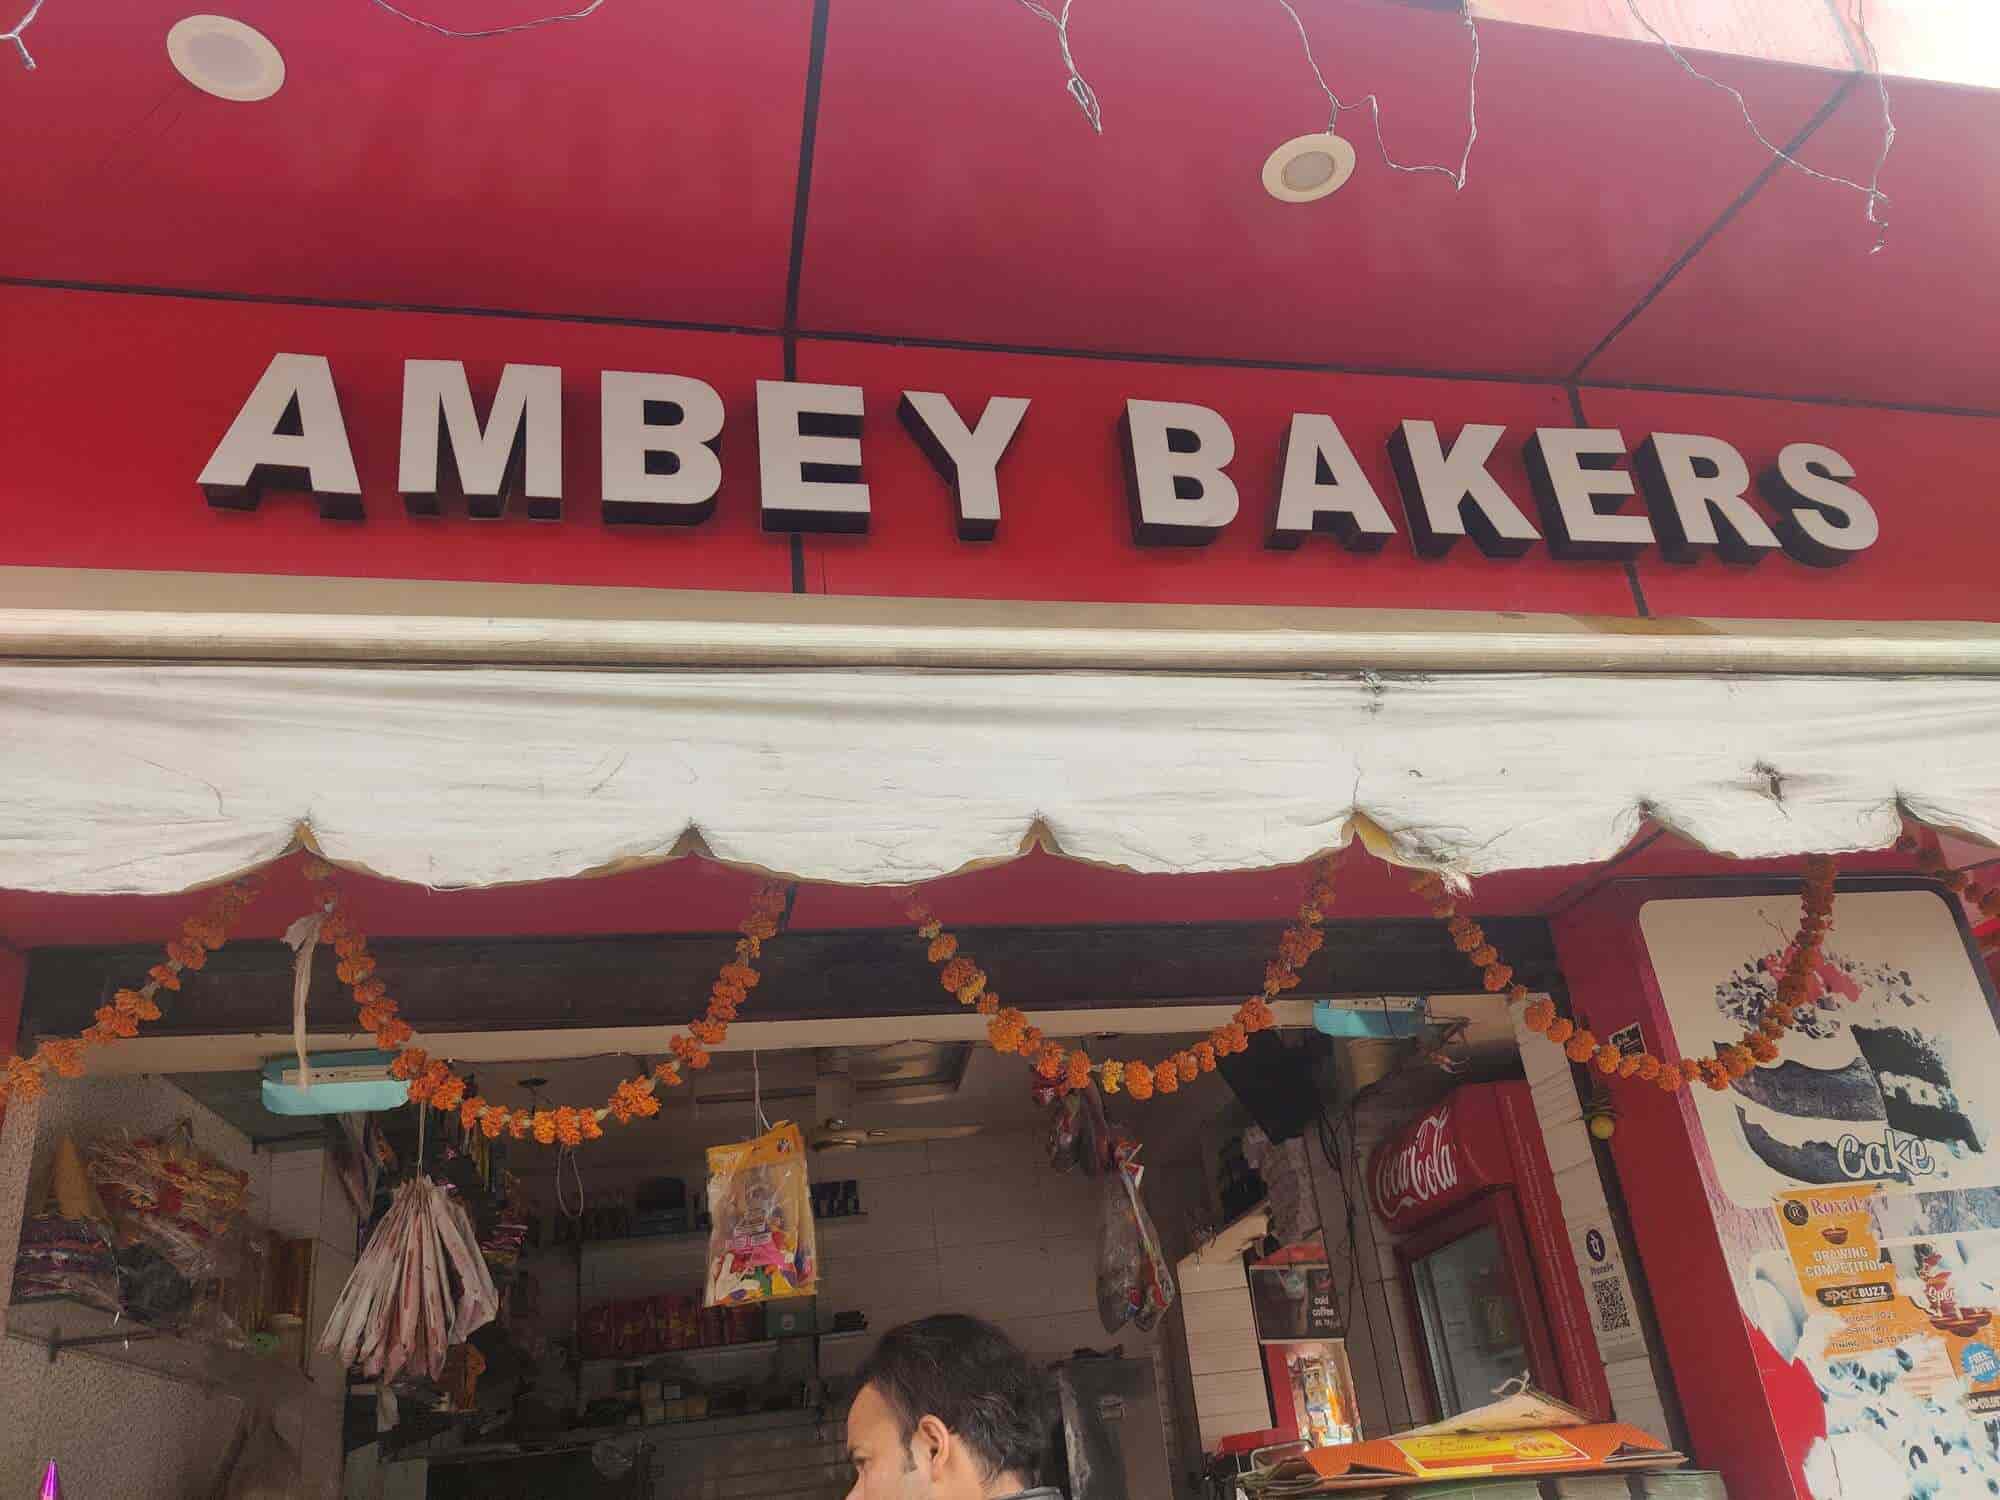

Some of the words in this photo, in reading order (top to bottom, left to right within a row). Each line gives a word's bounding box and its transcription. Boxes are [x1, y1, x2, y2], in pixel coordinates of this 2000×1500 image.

[197, 352, 1032, 528] AMBEY
[1127, 398, 1880, 556] BAKERS
[1837, 1128, 1936, 1180] Cake
